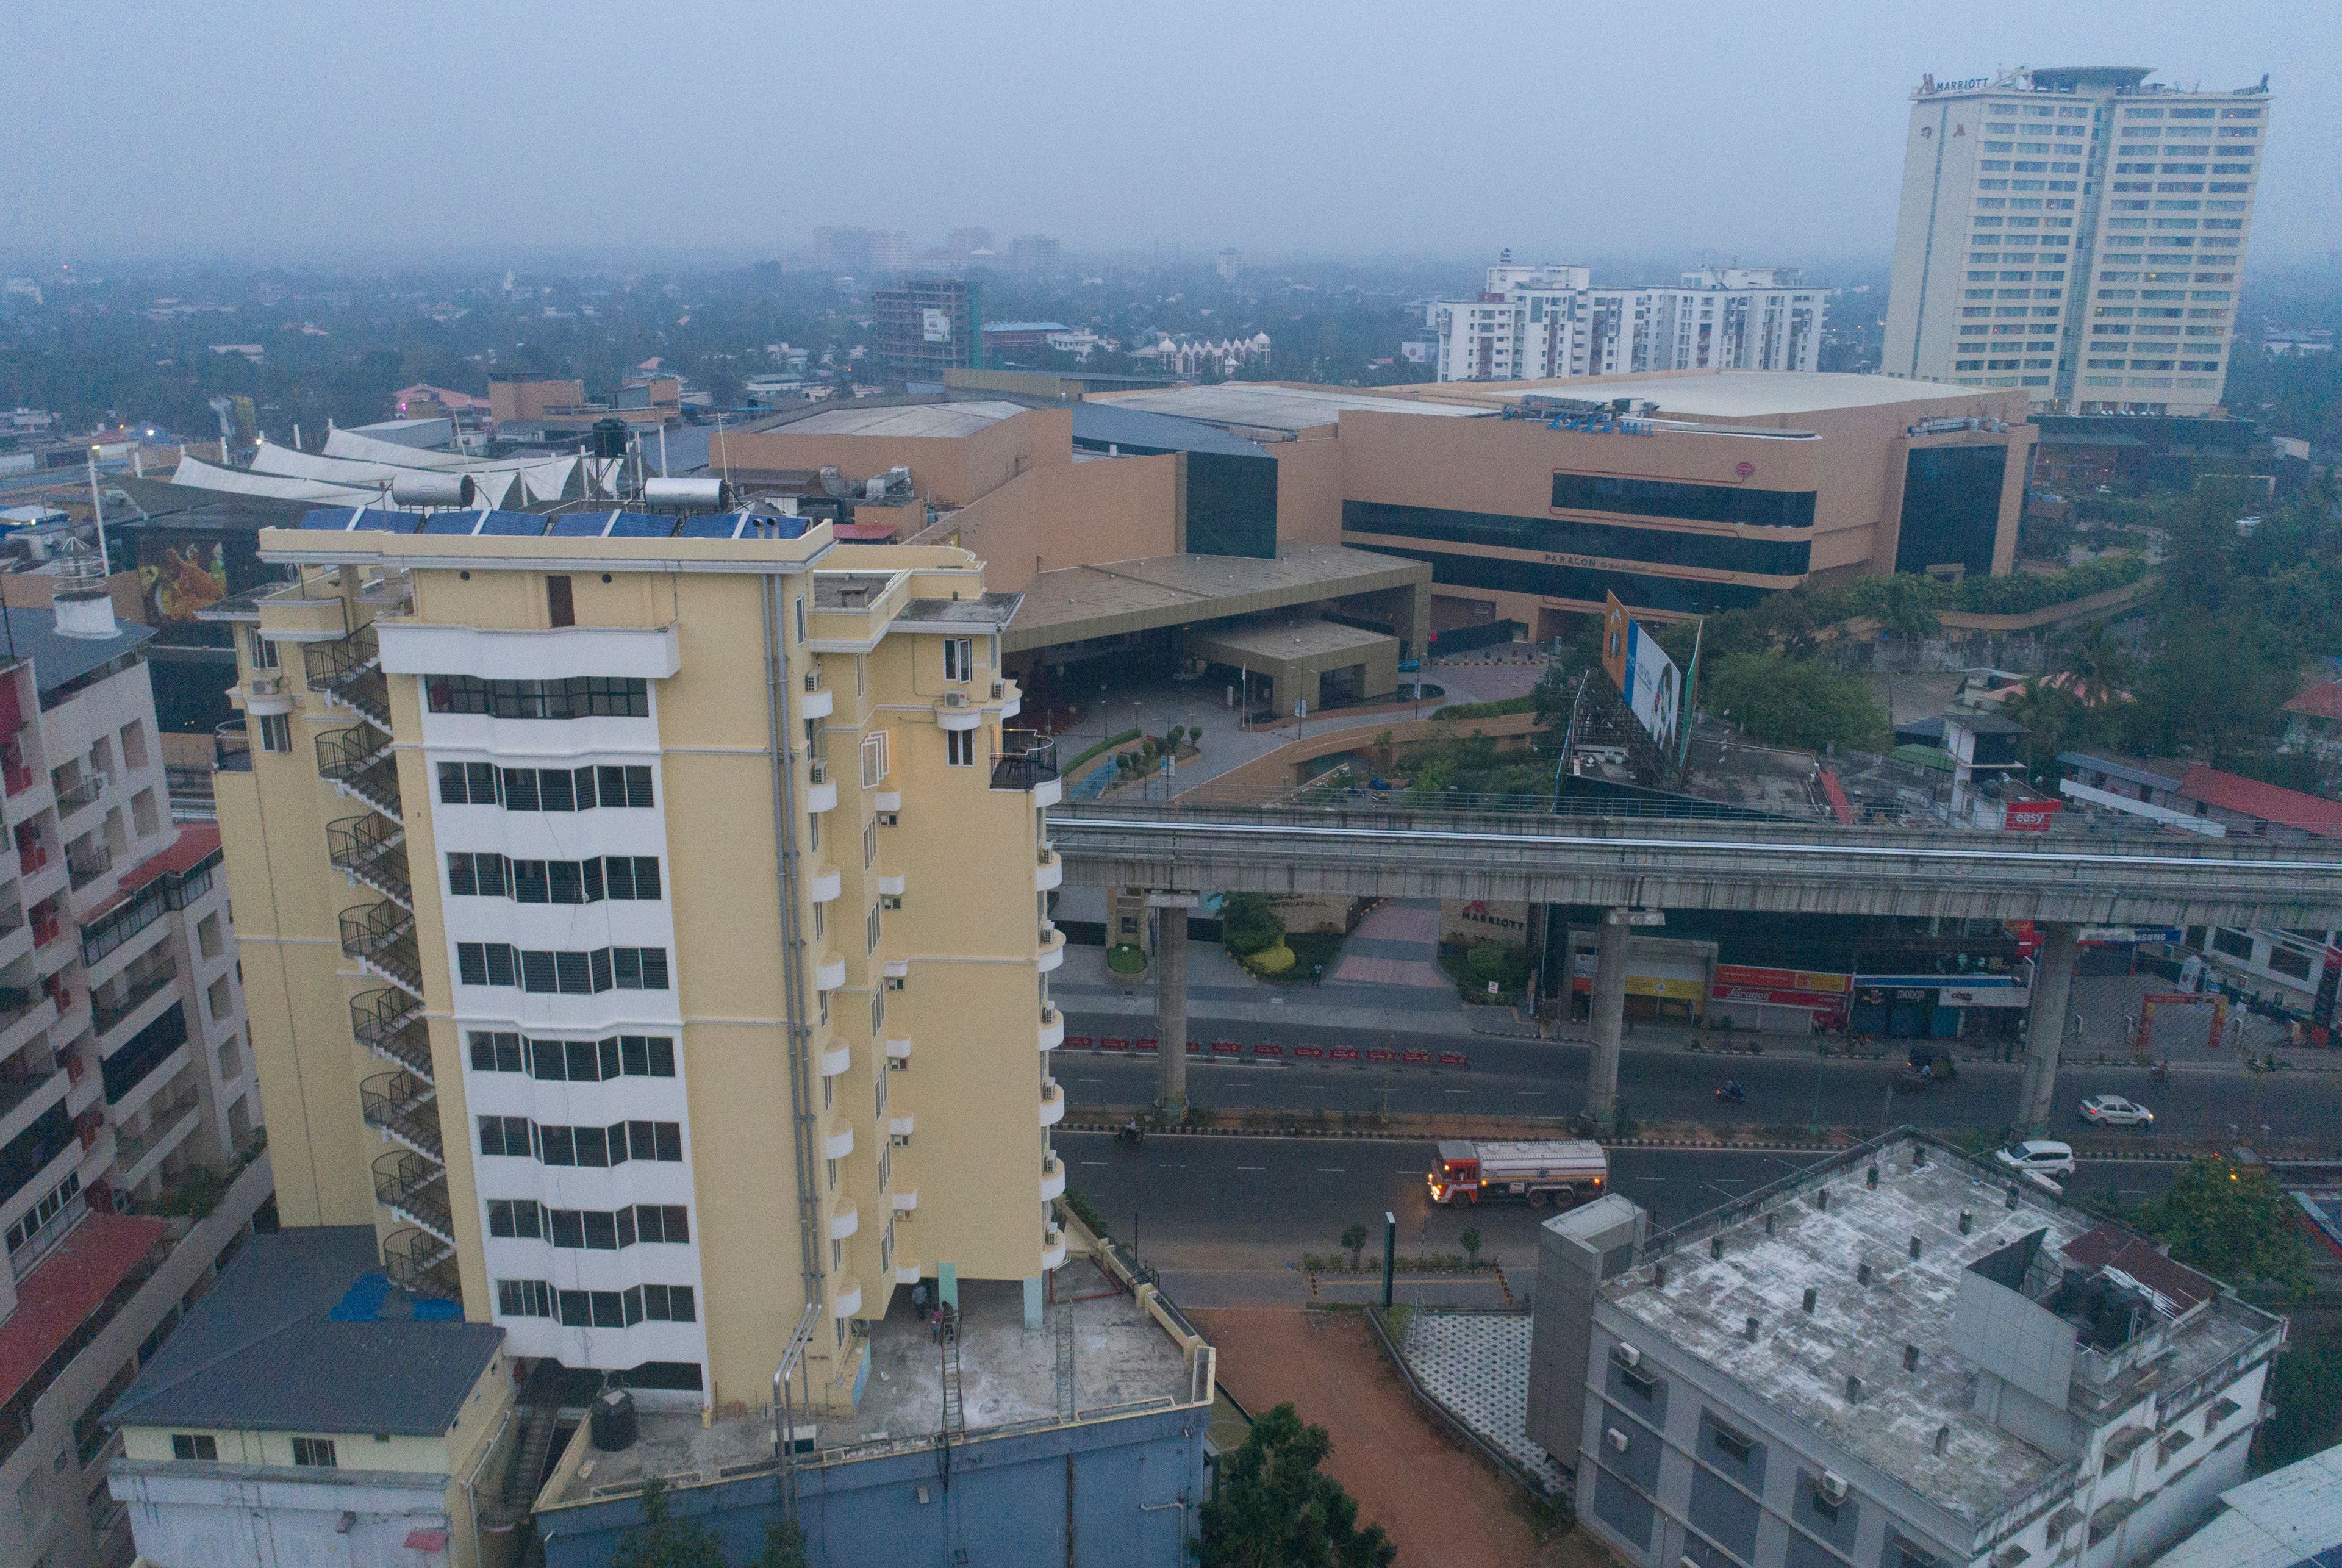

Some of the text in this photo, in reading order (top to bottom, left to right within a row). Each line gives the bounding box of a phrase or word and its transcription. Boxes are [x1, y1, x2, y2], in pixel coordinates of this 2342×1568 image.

[1936, 77, 1989, 91] MARRIOTT
[2016, 814, 2044, 824] easy
[1461, 912, 1524, 931] MARRIOTT
[2134, 933, 2166, 942] MSUNG
